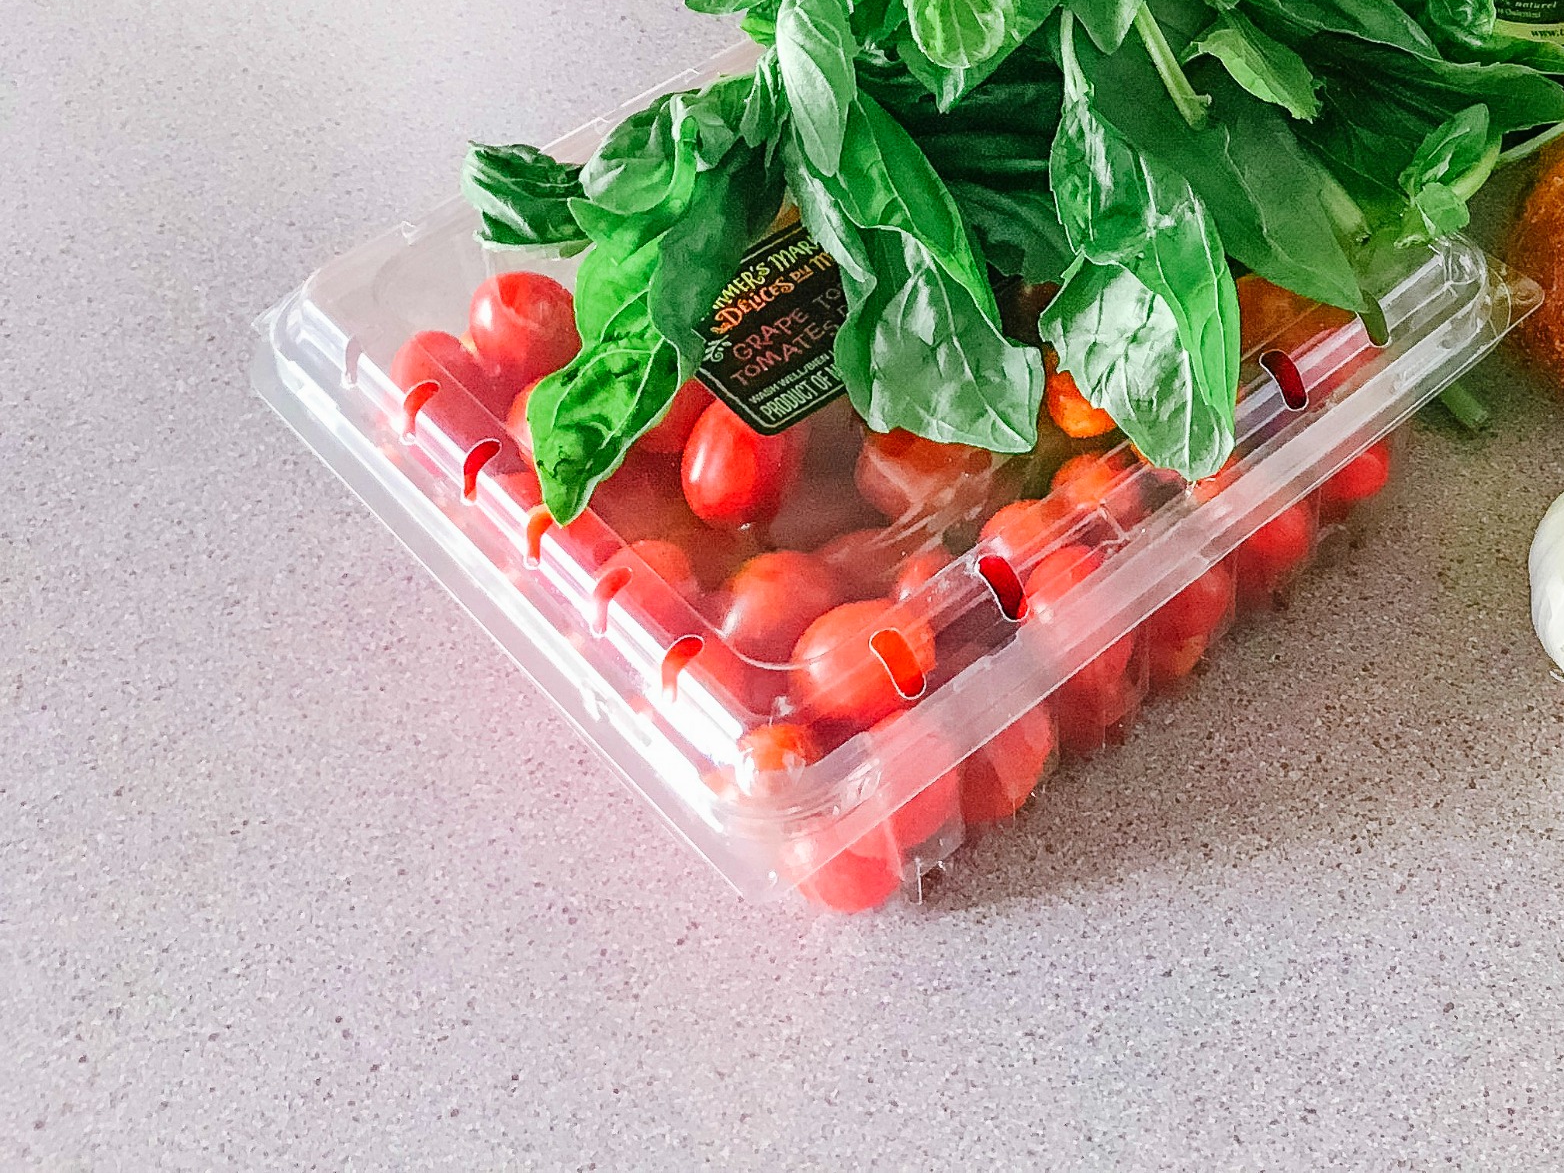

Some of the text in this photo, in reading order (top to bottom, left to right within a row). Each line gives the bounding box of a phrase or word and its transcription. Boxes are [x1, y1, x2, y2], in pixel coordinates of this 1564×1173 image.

[729, 319, 839, 386] TOMATES
[732, 307, 809, 361] GRAPE
[759, 379, 819, 422] PRODUCT
[810, 369, 834, 390] OF
